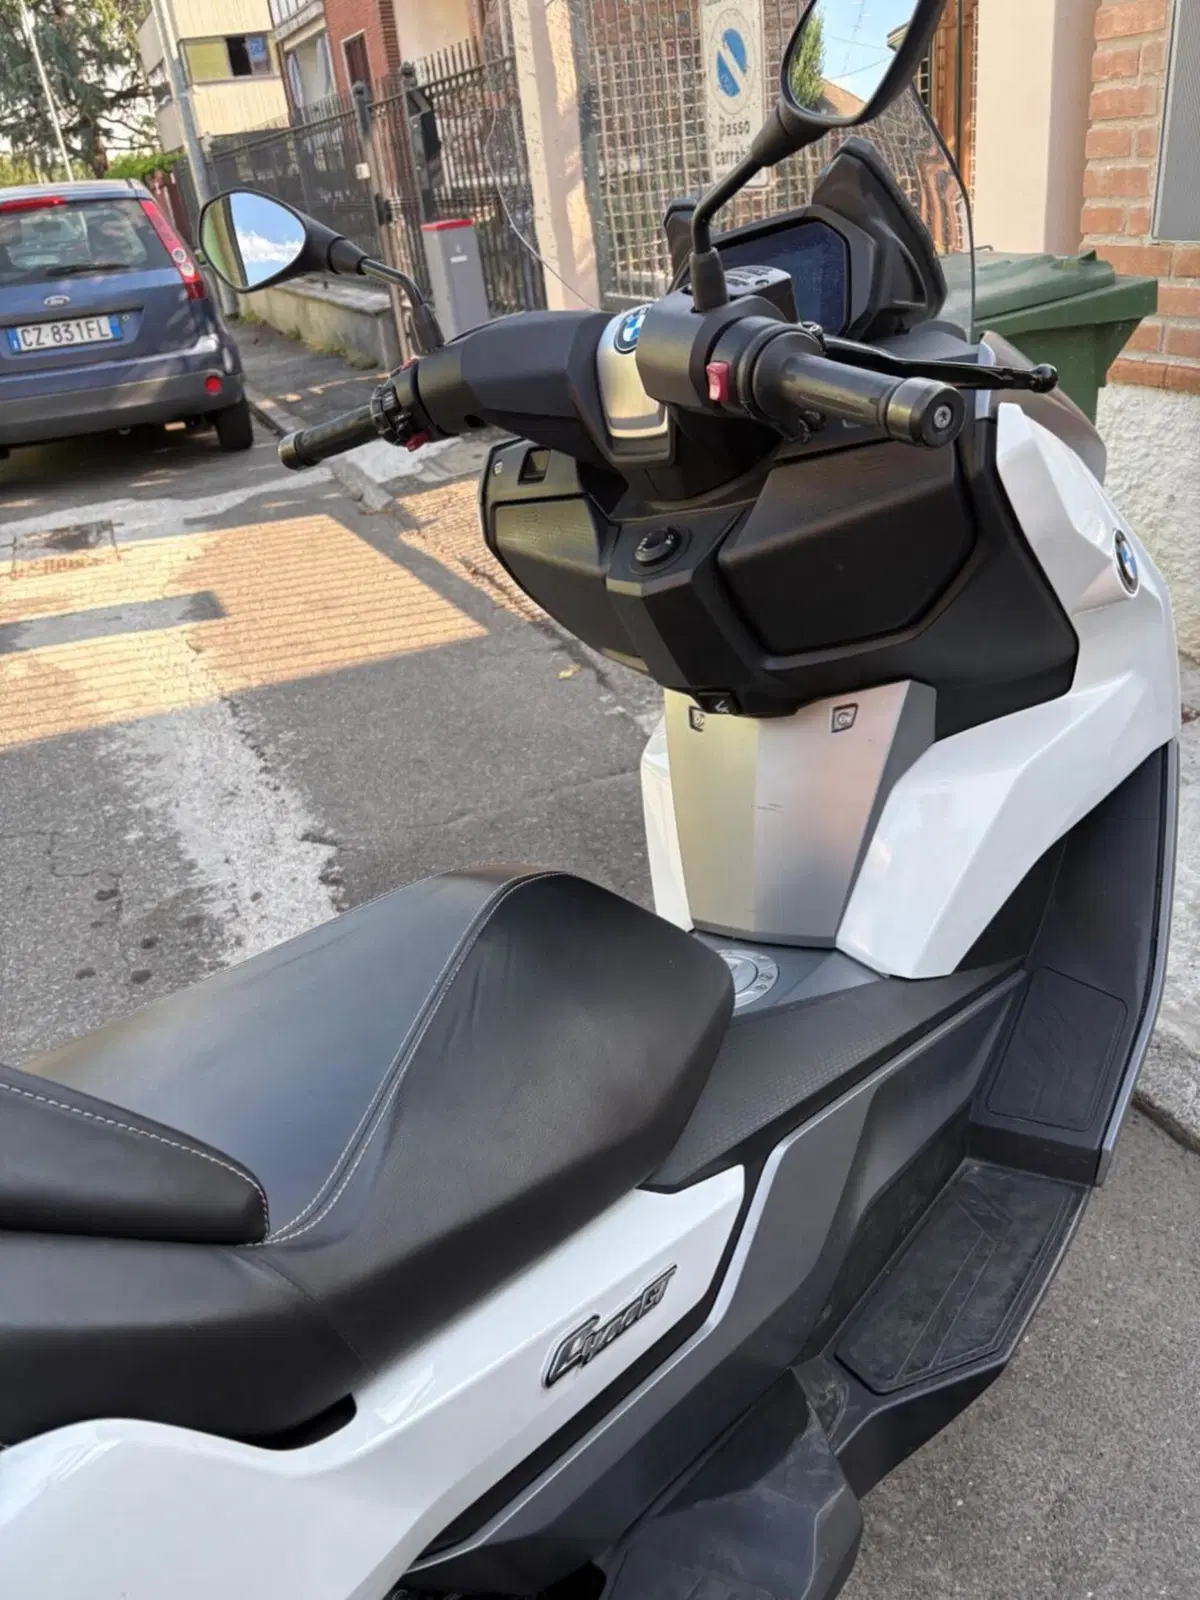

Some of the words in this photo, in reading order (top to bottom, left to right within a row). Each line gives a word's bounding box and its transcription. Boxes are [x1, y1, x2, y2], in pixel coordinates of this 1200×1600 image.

[719, 121, 750, 142] passo
[714, 145, 748, 167] carrab
[21, 327, 46, 347] CZ
[50, 319, 109, 343] 831FL
